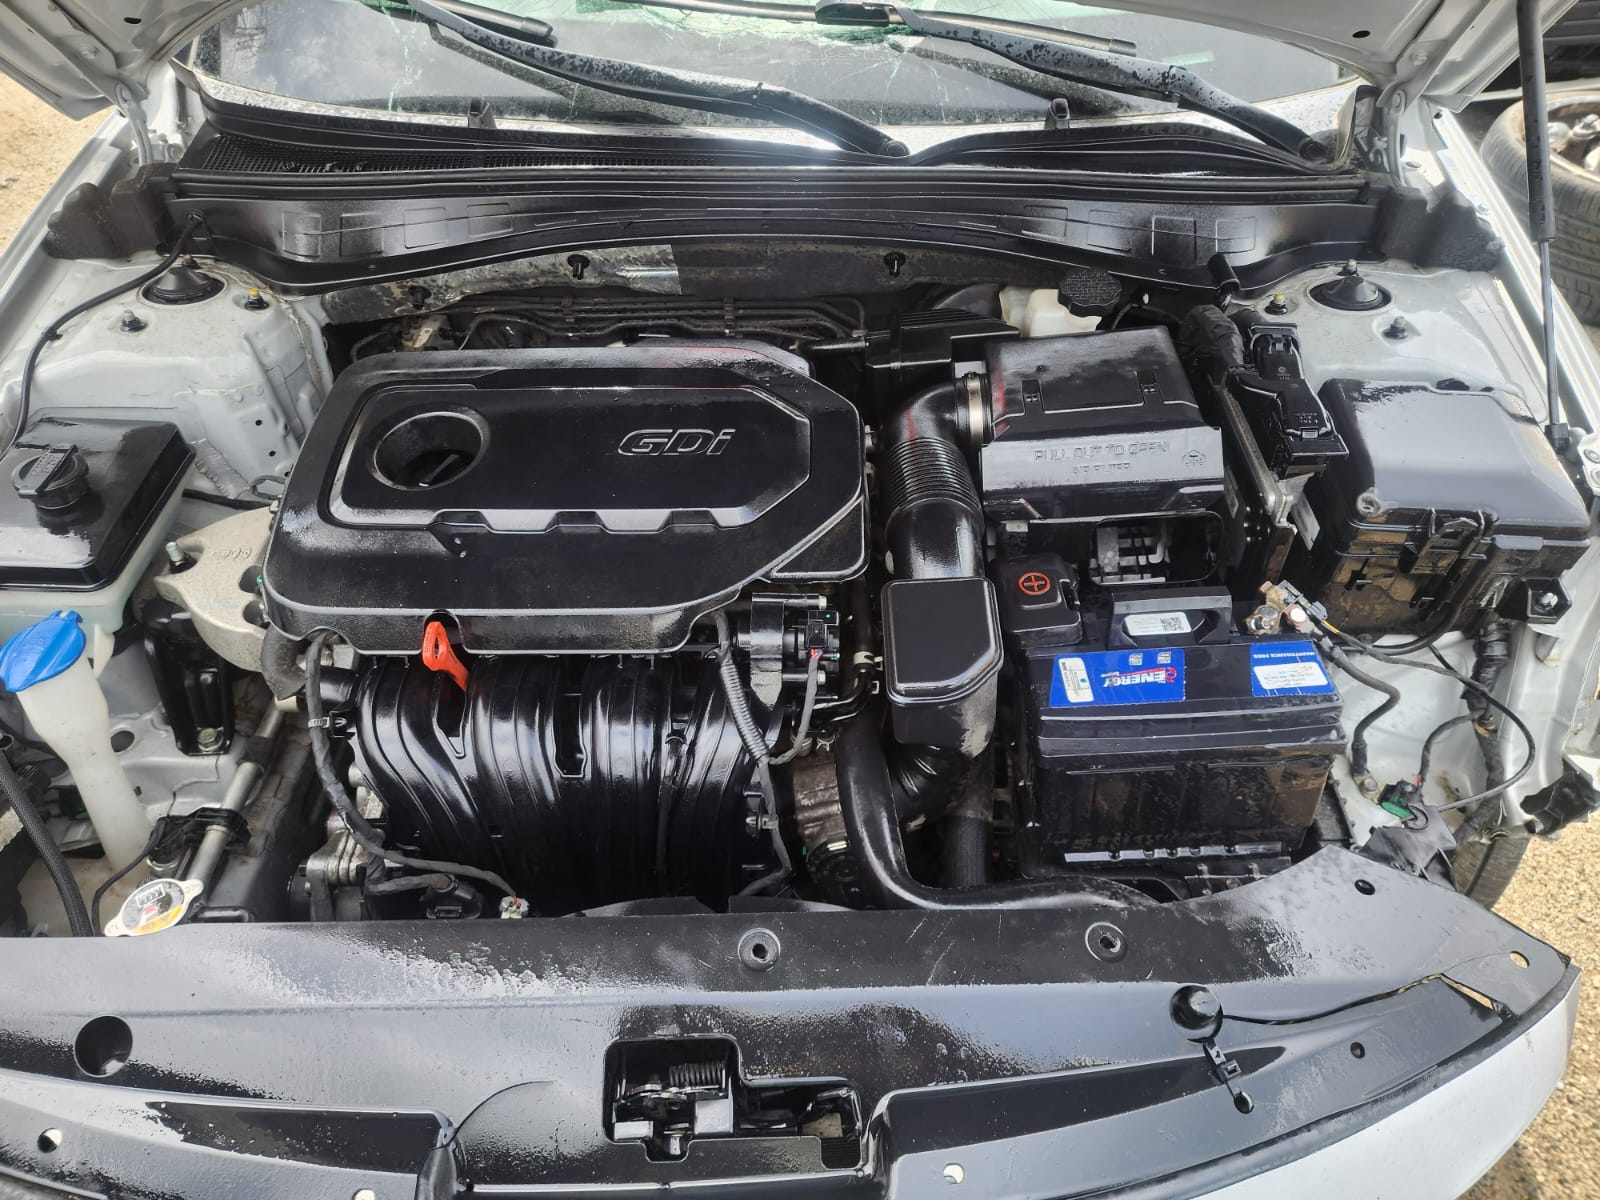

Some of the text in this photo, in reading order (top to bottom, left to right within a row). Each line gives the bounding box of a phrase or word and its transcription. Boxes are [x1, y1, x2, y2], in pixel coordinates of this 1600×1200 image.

[618, 428, 736, 456] GDi
[1034, 449, 1066, 461] PULL
[1073, 446, 1101, 459] OUT
[1105, 443, 1125, 456] TO
[1103, 669, 1166, 688] ENERGY
